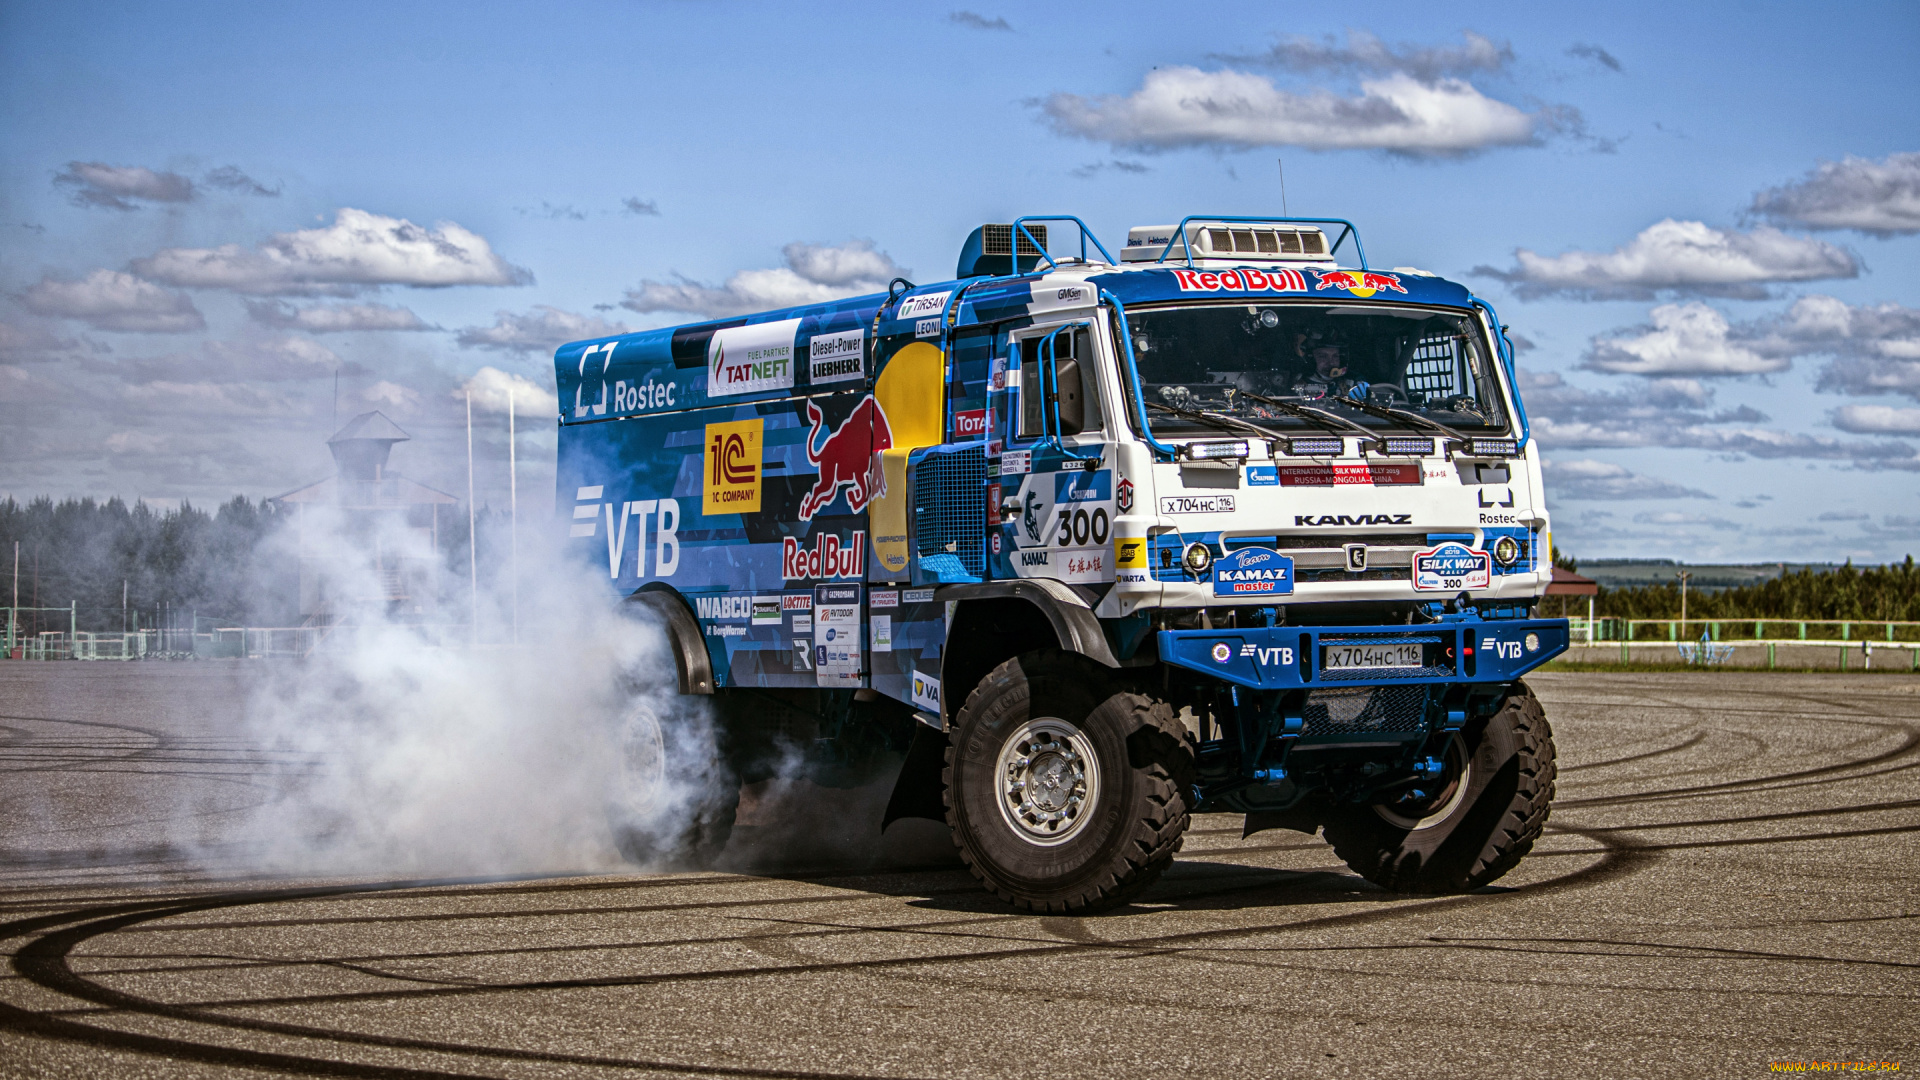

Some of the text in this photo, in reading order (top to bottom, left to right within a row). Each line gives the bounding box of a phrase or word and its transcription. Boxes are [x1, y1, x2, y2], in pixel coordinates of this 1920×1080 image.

[1172, 269, 1308, 293] Red Bull
[916, 320, 940, 335] LEONI
[748, 346, 790, 361] FUEL PARTNER
[812, 337, 861, 357] Diesel-Power
[726, 358, 790, 384] TATNEFT
[812, 360, 861, 378] LIEBHERR
[614, 380, 676, 413] Rostec
[1281, 467, 1400, 476] INTERNATIONAL SILK WAY RALLY 2019
[722, 489, 755, 502] COMPANY
[1076, 489, 1097, 499] GAZPROM
[1219, 498, 1231, 506] 116
[1294, 514, 1412, 526] KAMAZ
[1479, 513, 1516, 524] Rostec
[1058, 507, 1109, 547] 300
[605, 498, 681, 578] VTB
[782, 530, 866, 580] Red Bull
[1021, 551, 1048, 566] KAMAZ
[1121, 549, 1135, 557] ESAB
[1236, 550, 1271, 568] Team
[1421, 558, 1483, 570] SILK WAY
[1122, 575, 1146, 583] VARTA
[1219, 568, 1287, 582] KAMAZ
[1234, 581, 1275, 592] master
[1443, 579, 1462, 588] 300
[904, 590, 934, 601] ICEQUEE
[696, 596, 751, 619] WABCO
[783, 596, 811, 610] LOCTITE
[713, 625, 747, 638] BorgWarner
[1257, 647, 1293, 666] VTB
[1396, 646, 1418, 660] 116
[1495, 641, 1522, 659] VTB
[925, 683, 939, 703] VA
